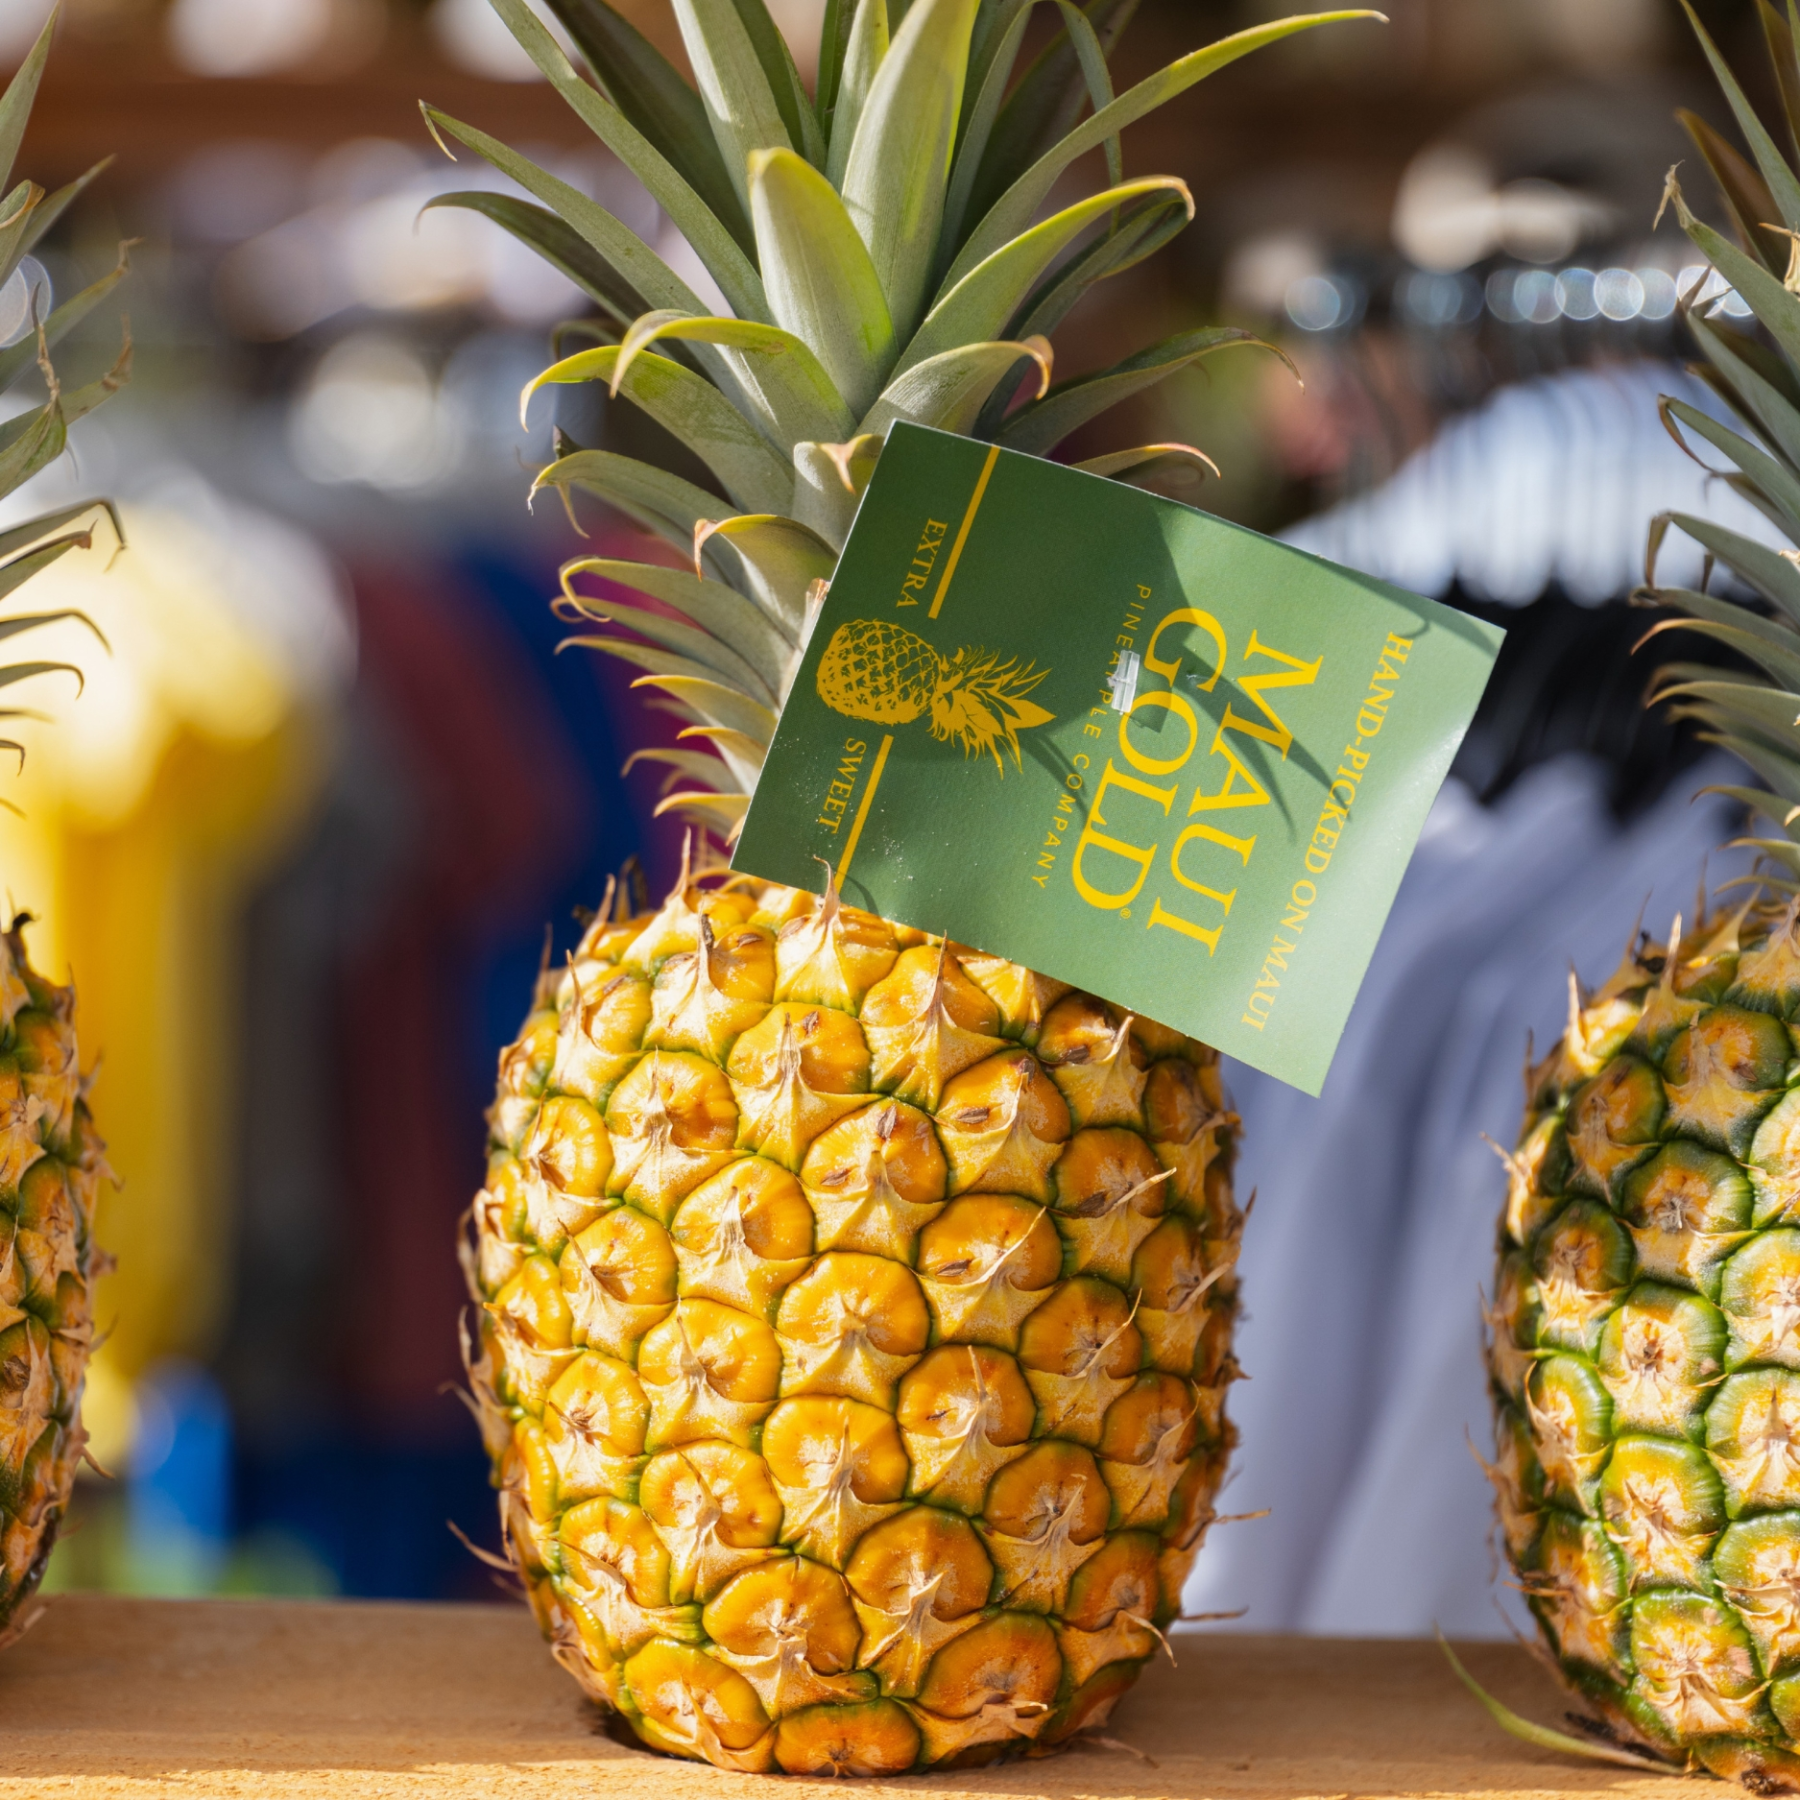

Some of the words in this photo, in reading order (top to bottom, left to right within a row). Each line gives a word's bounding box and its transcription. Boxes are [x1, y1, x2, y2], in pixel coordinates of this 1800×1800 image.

[895, 518, 948, 608] EXTRA
[1083, 584, 1152, 739] PINEAPLE
[818, 737, 867, 835] SWEET
[1146, 628, 1324, 958] MAUI
[1304, 631, 1414, 874] HAND-PICKED
[1031, 753, 1090, 889] COMPANY
[1279, 879, 1317, 935] ON
[1240, 934, 1297, 1032] MAUI
